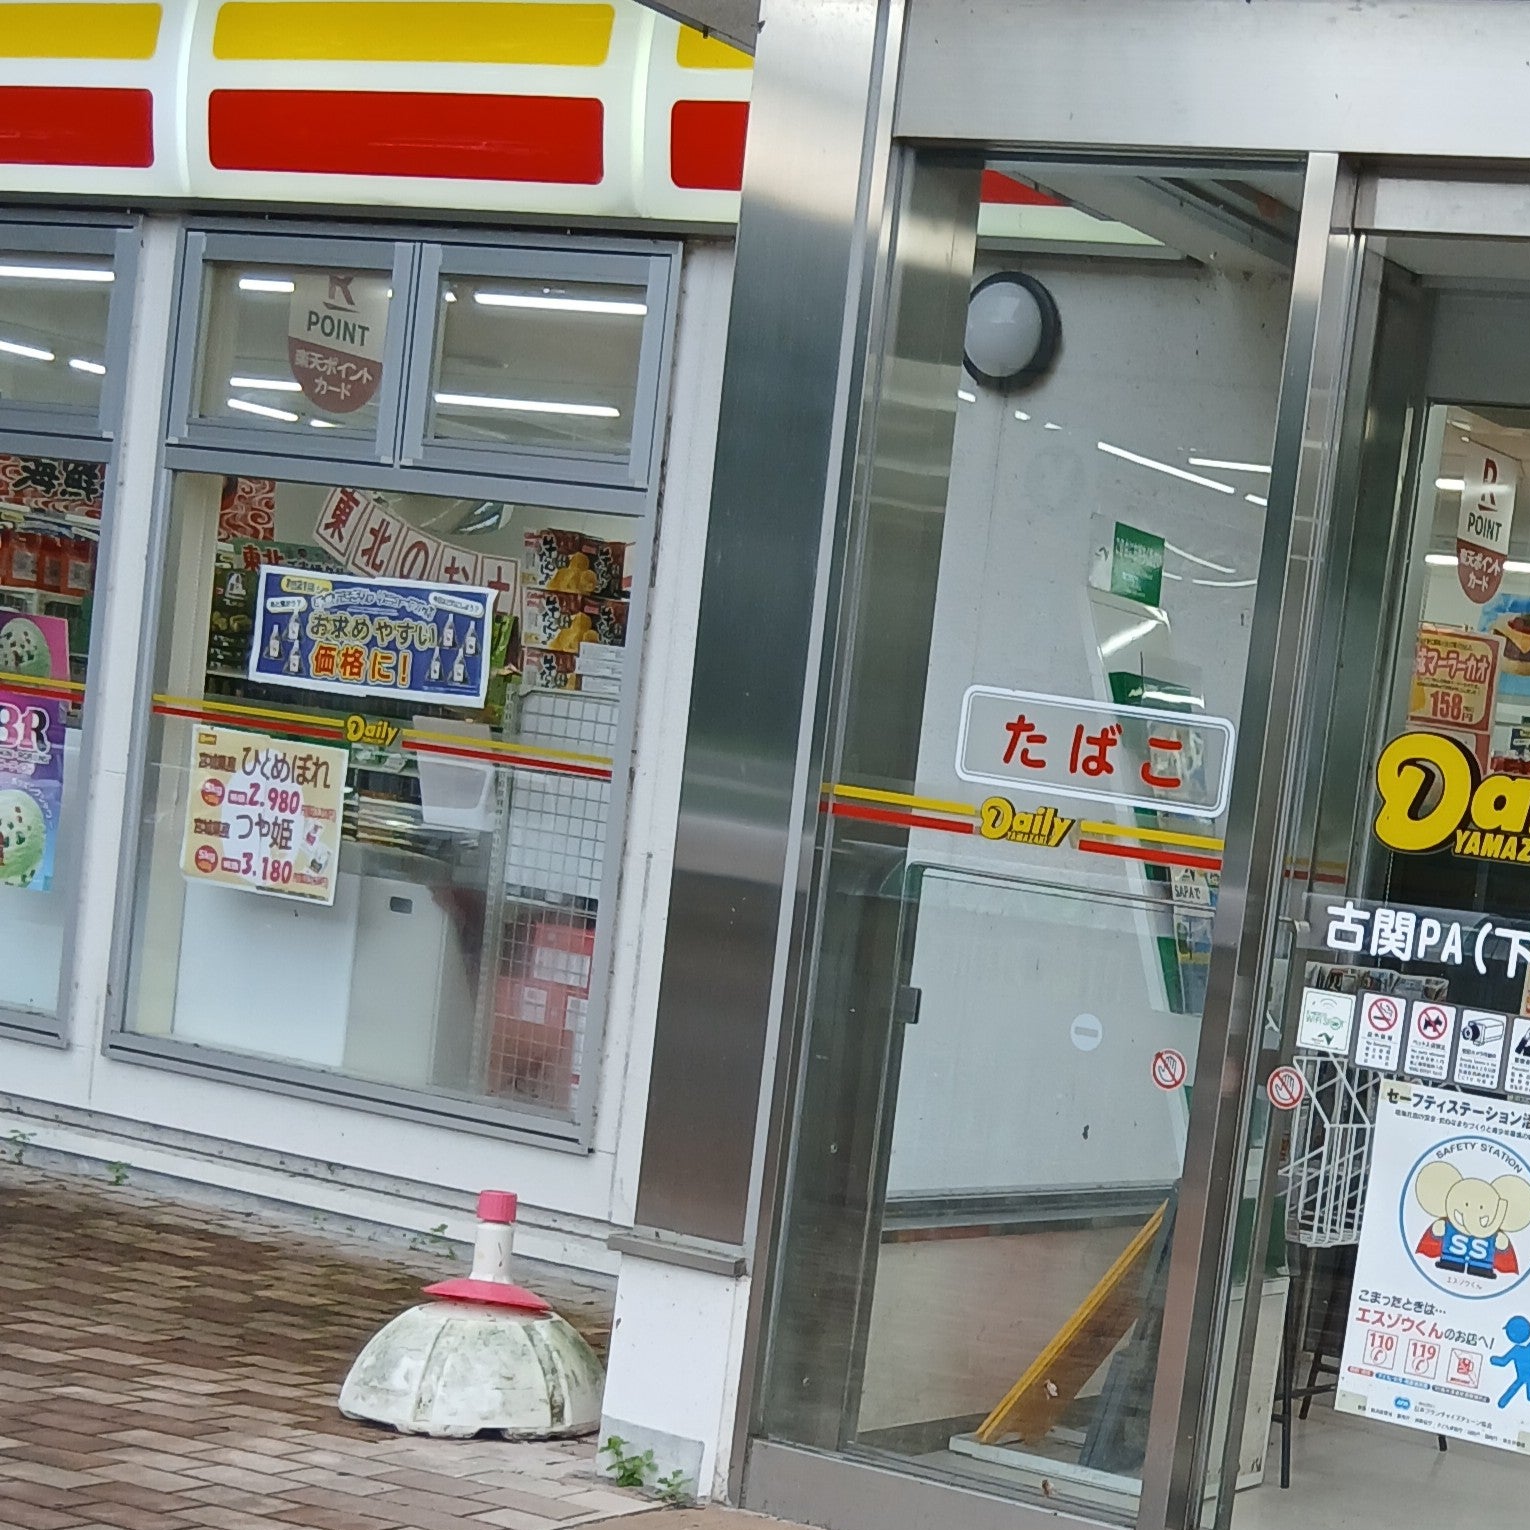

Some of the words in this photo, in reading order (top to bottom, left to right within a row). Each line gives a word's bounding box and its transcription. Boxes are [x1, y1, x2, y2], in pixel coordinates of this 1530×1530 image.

[307, 310, 370, 347] POINT
[314, 376, 352, 400] カード
[1467, 512, 1503, 543] POINT
[309, 615, 437, 648] お求めやすい
[313, 645, 411, 683] 価格に!
[347, 714, 400, 746] Daily
[241, 747, 331, 788] ひとめぼれ
[1003, 714, 1183, 788] たばこ
[236, 812, 295, 850] つや姫
[980, 796, 1076, 848] Daily
[1436, 1142, 1478, 1160] SAFETY
[1480, 1142, 1524, 1174] STATION
[1449, 1234, 1489, 1260] SS
[1369, 1332, 1394, 1351] 110
[1411, 1342, 1437, 1360] 119
